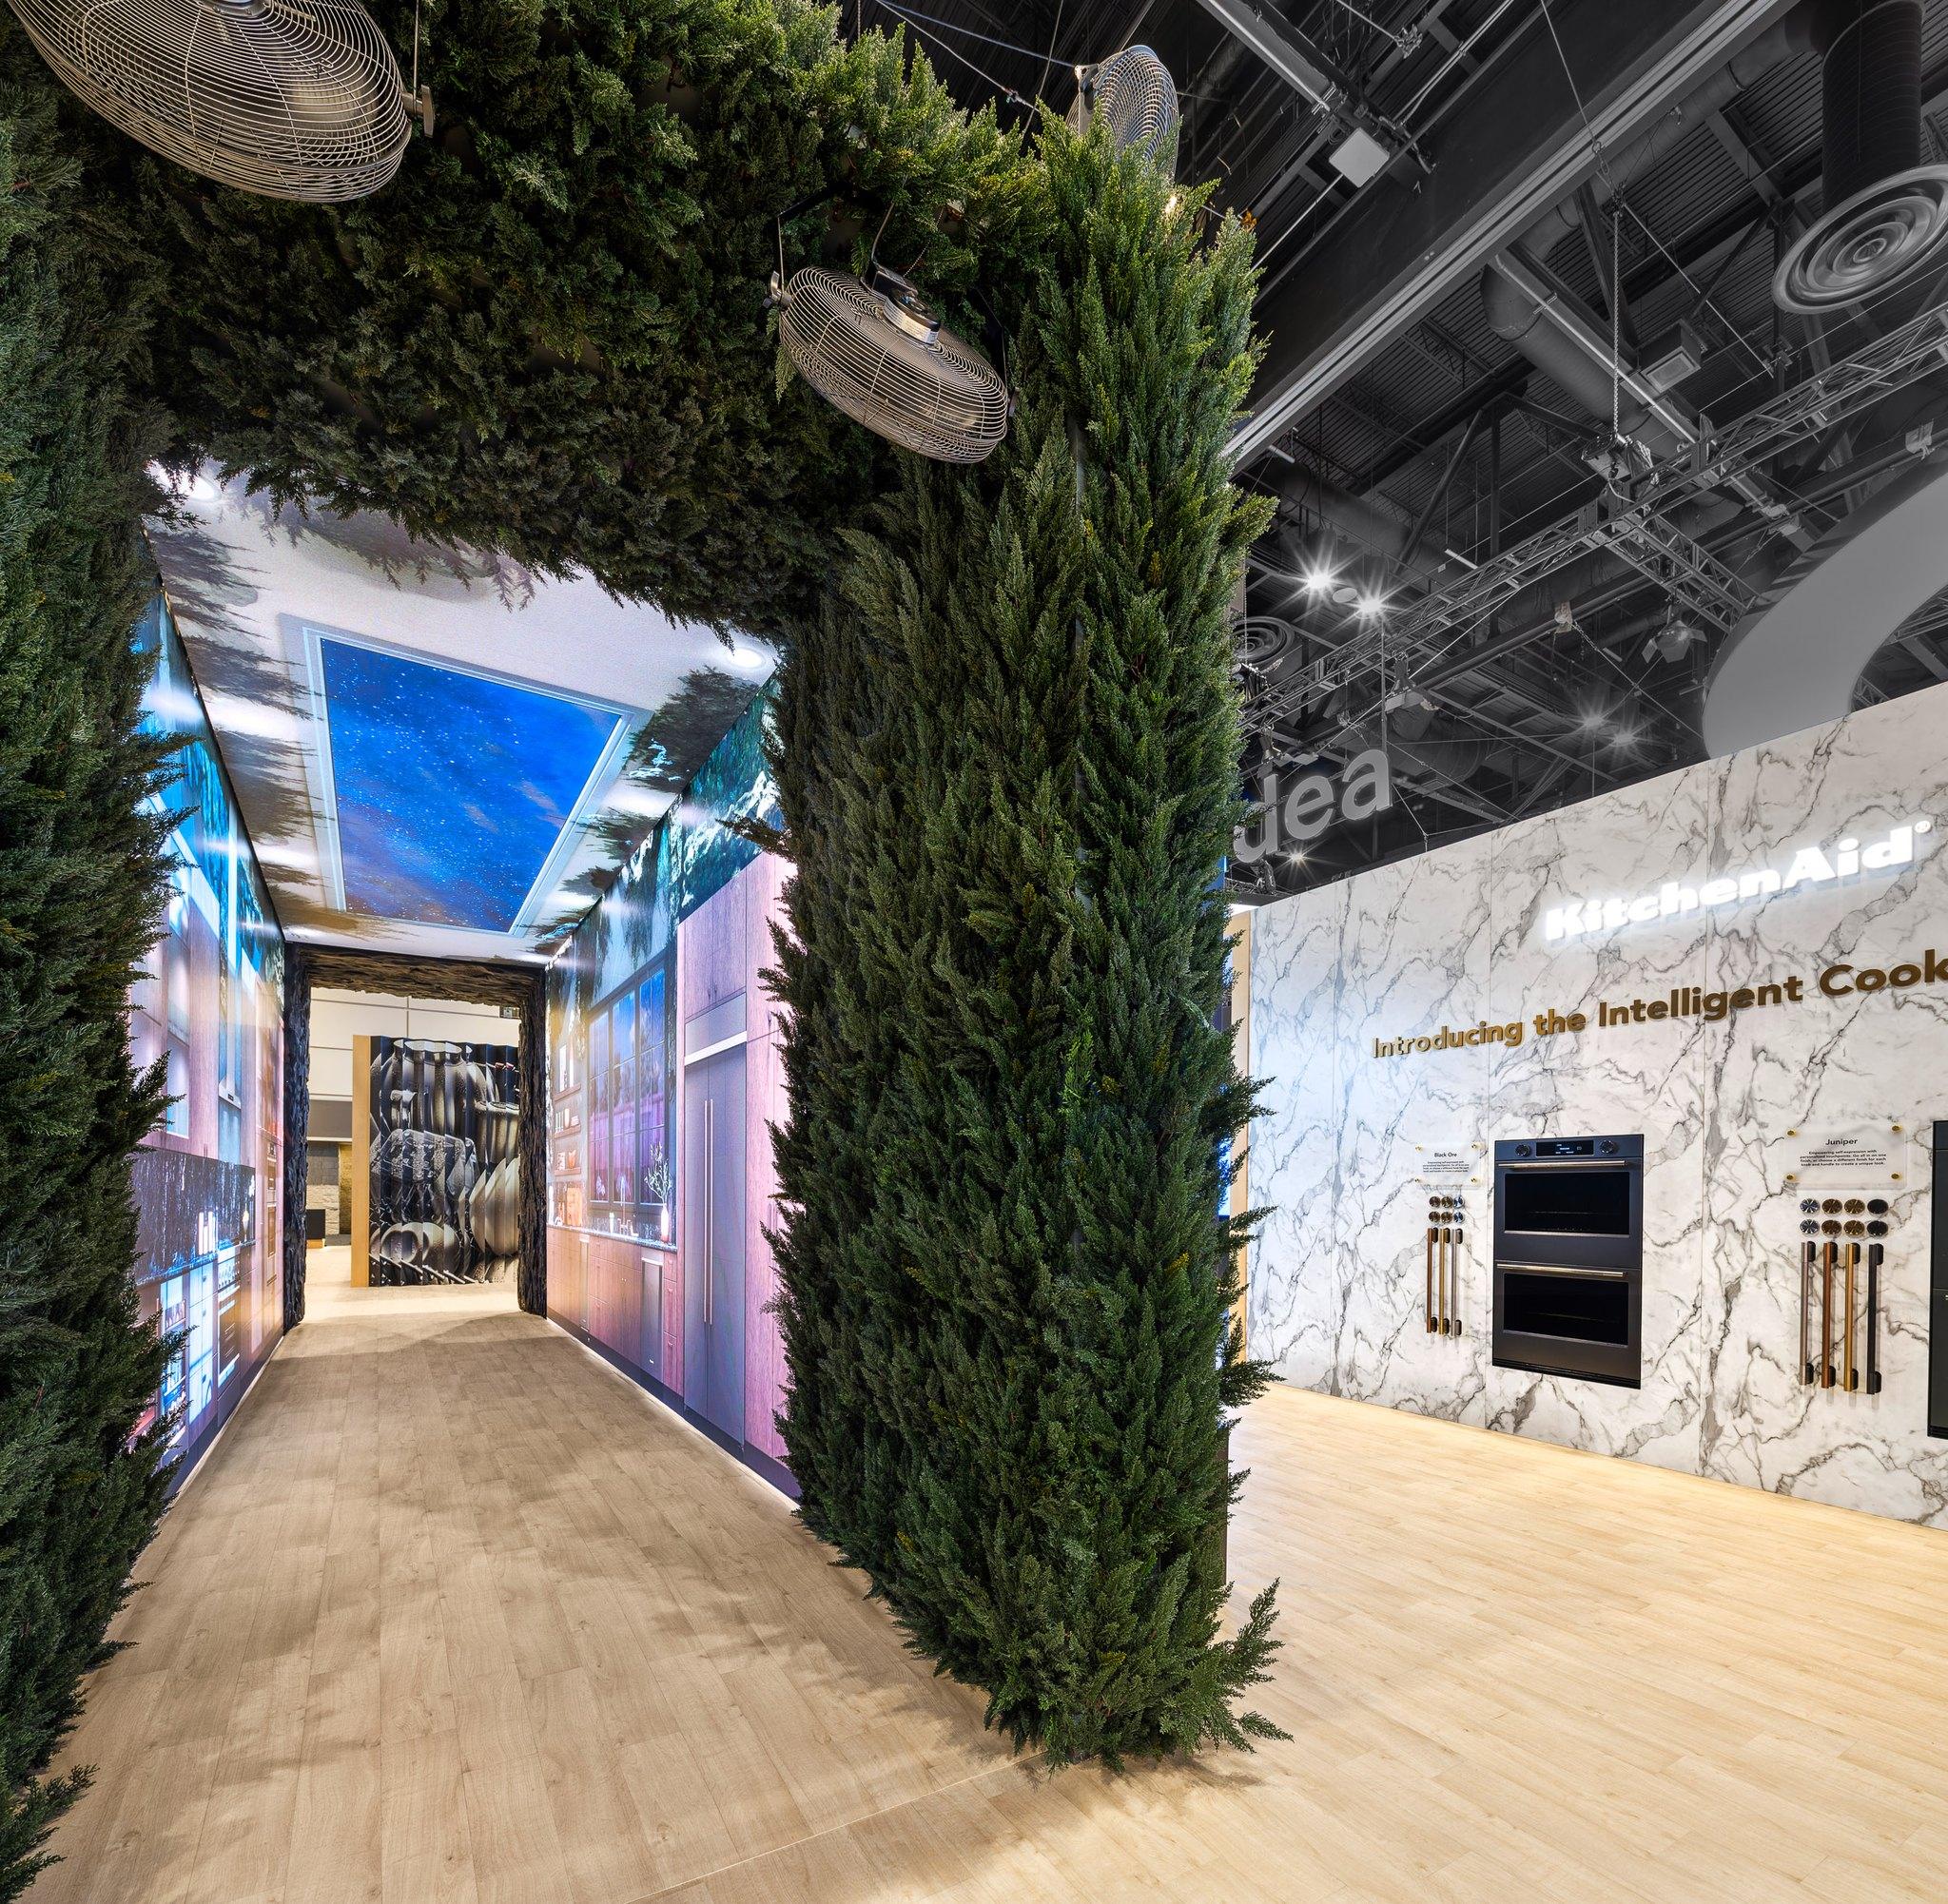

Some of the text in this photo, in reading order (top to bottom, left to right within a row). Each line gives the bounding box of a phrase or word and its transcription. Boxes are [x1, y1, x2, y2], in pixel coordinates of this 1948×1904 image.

[1373, 1020, 1525, 1059] Introducing
[1532, 1008, 1587, 1037] the
[1598, 975, 1804, 1027] Intelligent
